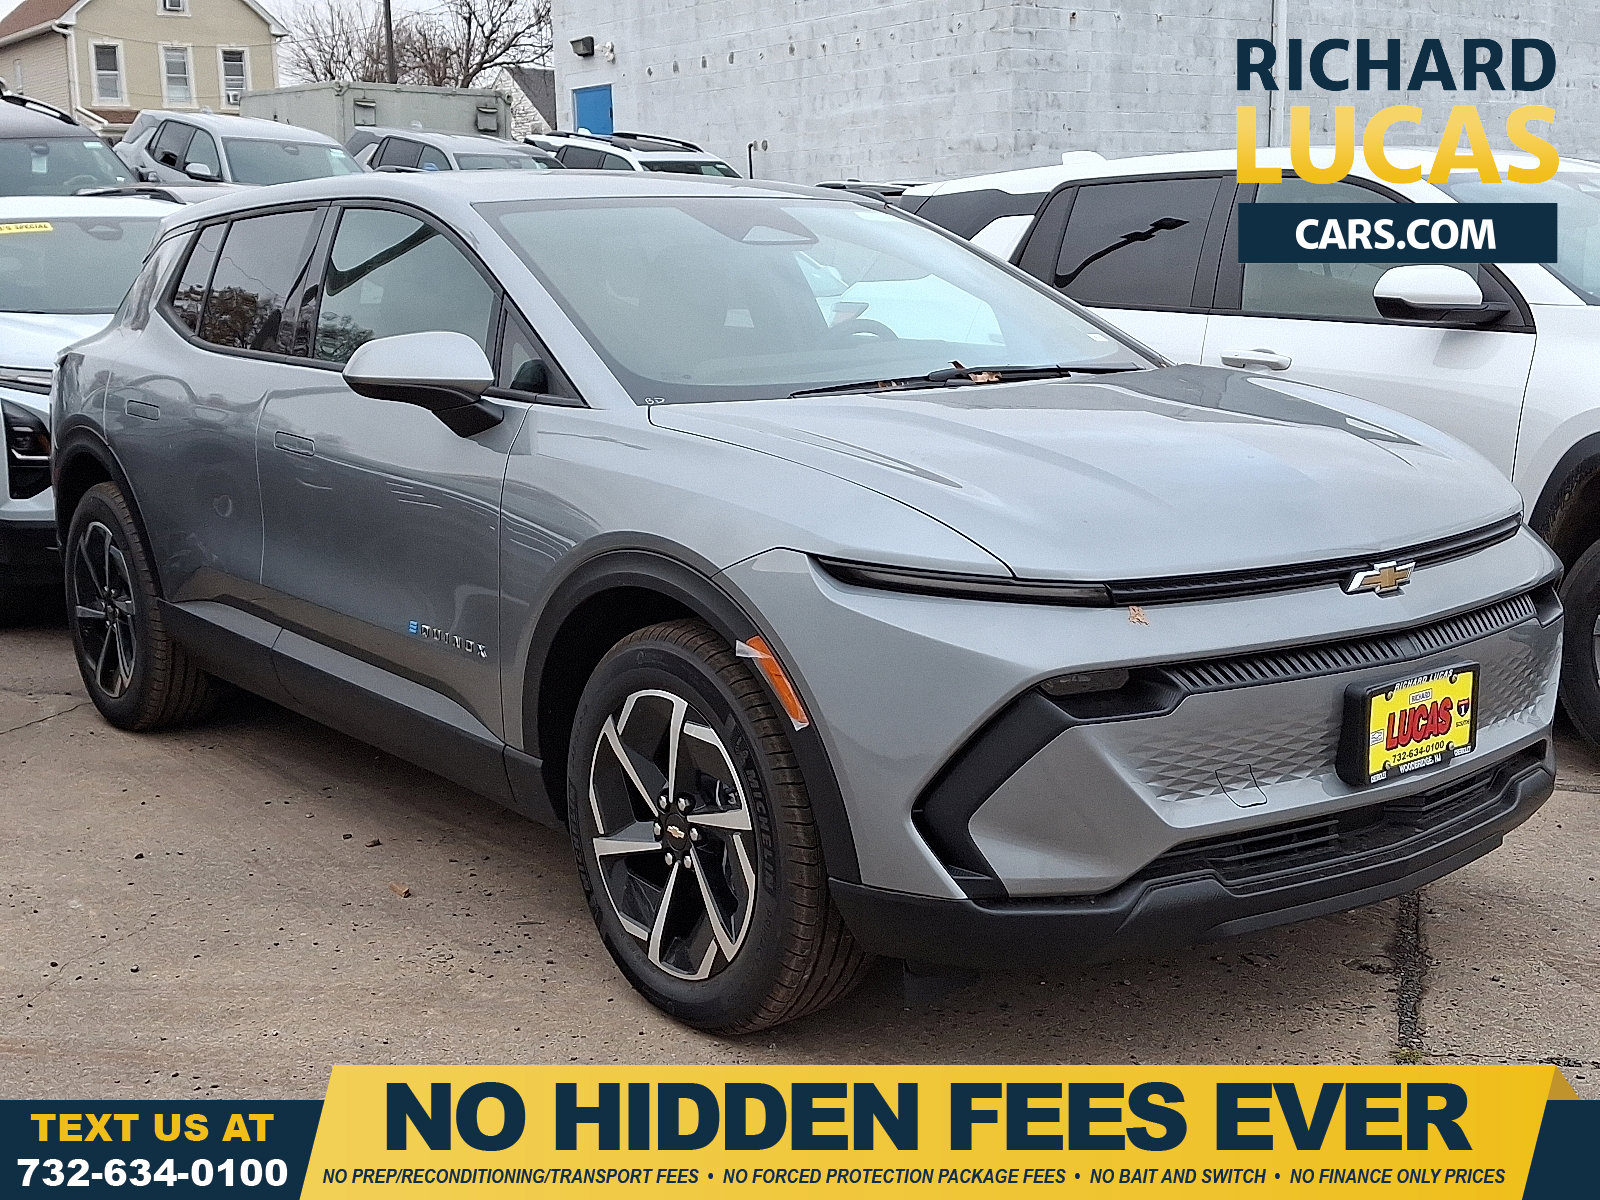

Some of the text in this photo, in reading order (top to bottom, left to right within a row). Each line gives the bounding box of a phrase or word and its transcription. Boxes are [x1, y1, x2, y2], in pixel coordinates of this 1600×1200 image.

[1394, 669, 1454, 690] RICHARD LUCAS
[1385, 697, 1454, 751] LUCAS
[1391, 740, 1445, 764] 732-634-0100
[746, 769, 777, 892] MICHELIN
